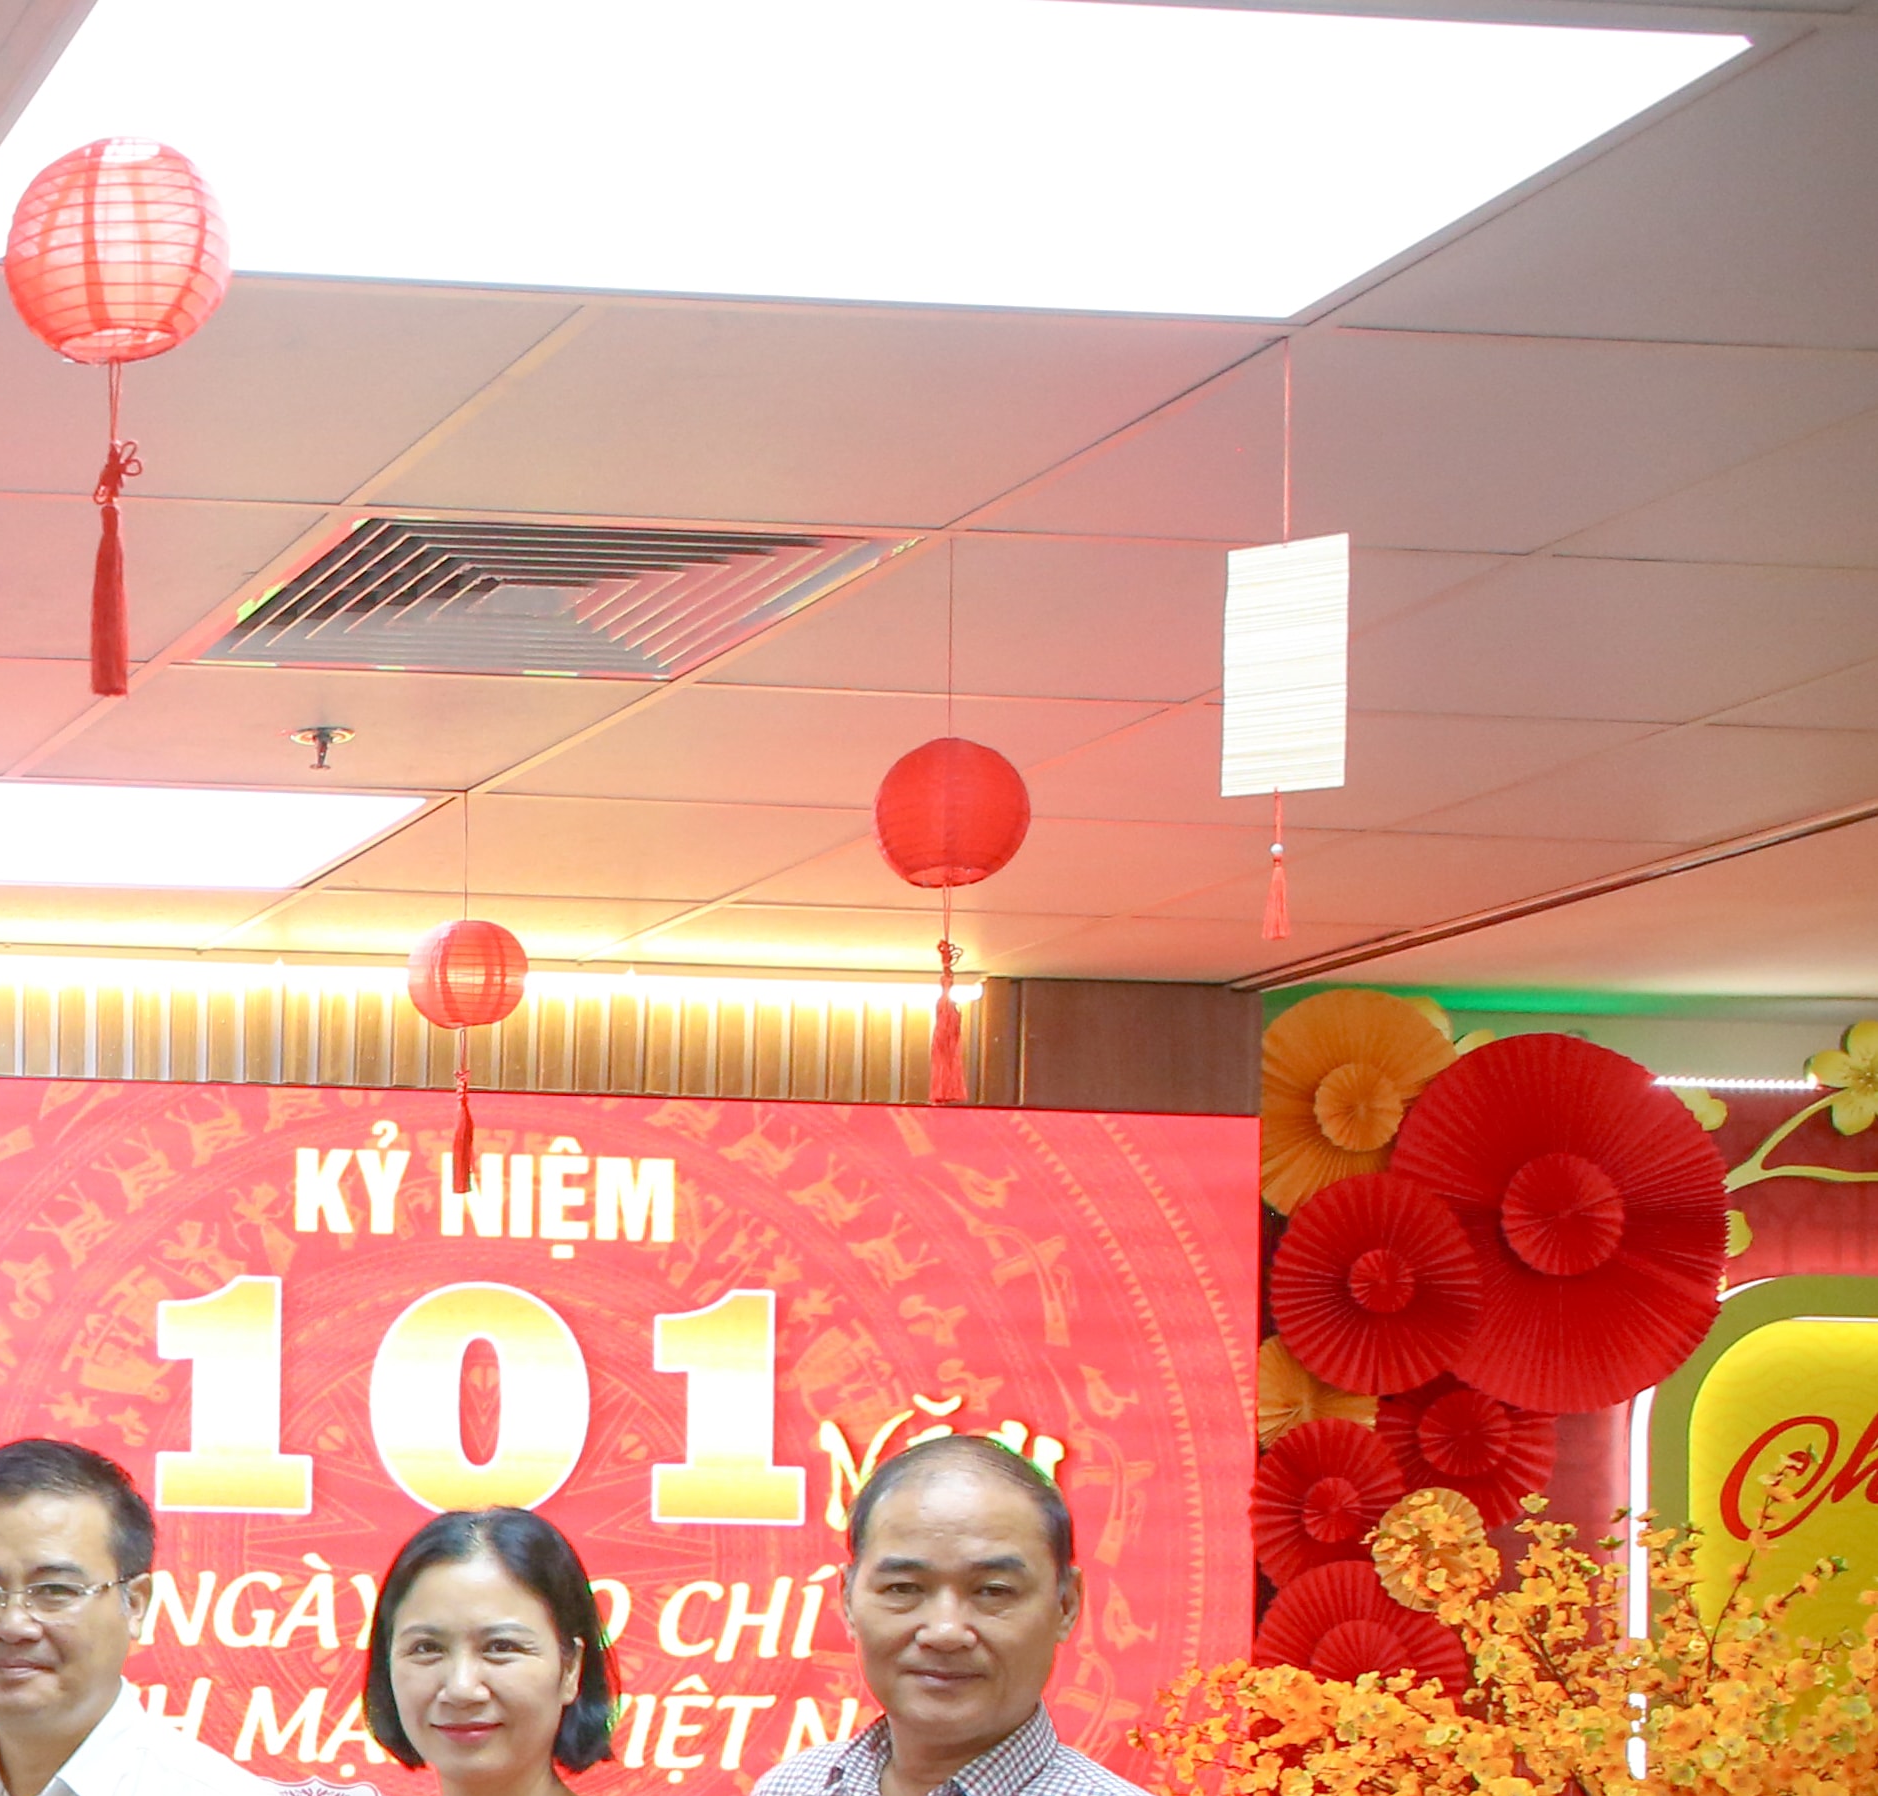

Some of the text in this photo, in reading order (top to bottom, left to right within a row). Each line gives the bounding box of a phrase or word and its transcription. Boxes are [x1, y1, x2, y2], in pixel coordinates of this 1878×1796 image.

[294, 1120, 676, 1259] KỶ NIỆM
[155, 1275, 806, 1526] 101
[657, 1563, 837, 1662] CHÍ
[233, 1686, 393, 1778] MẠ
